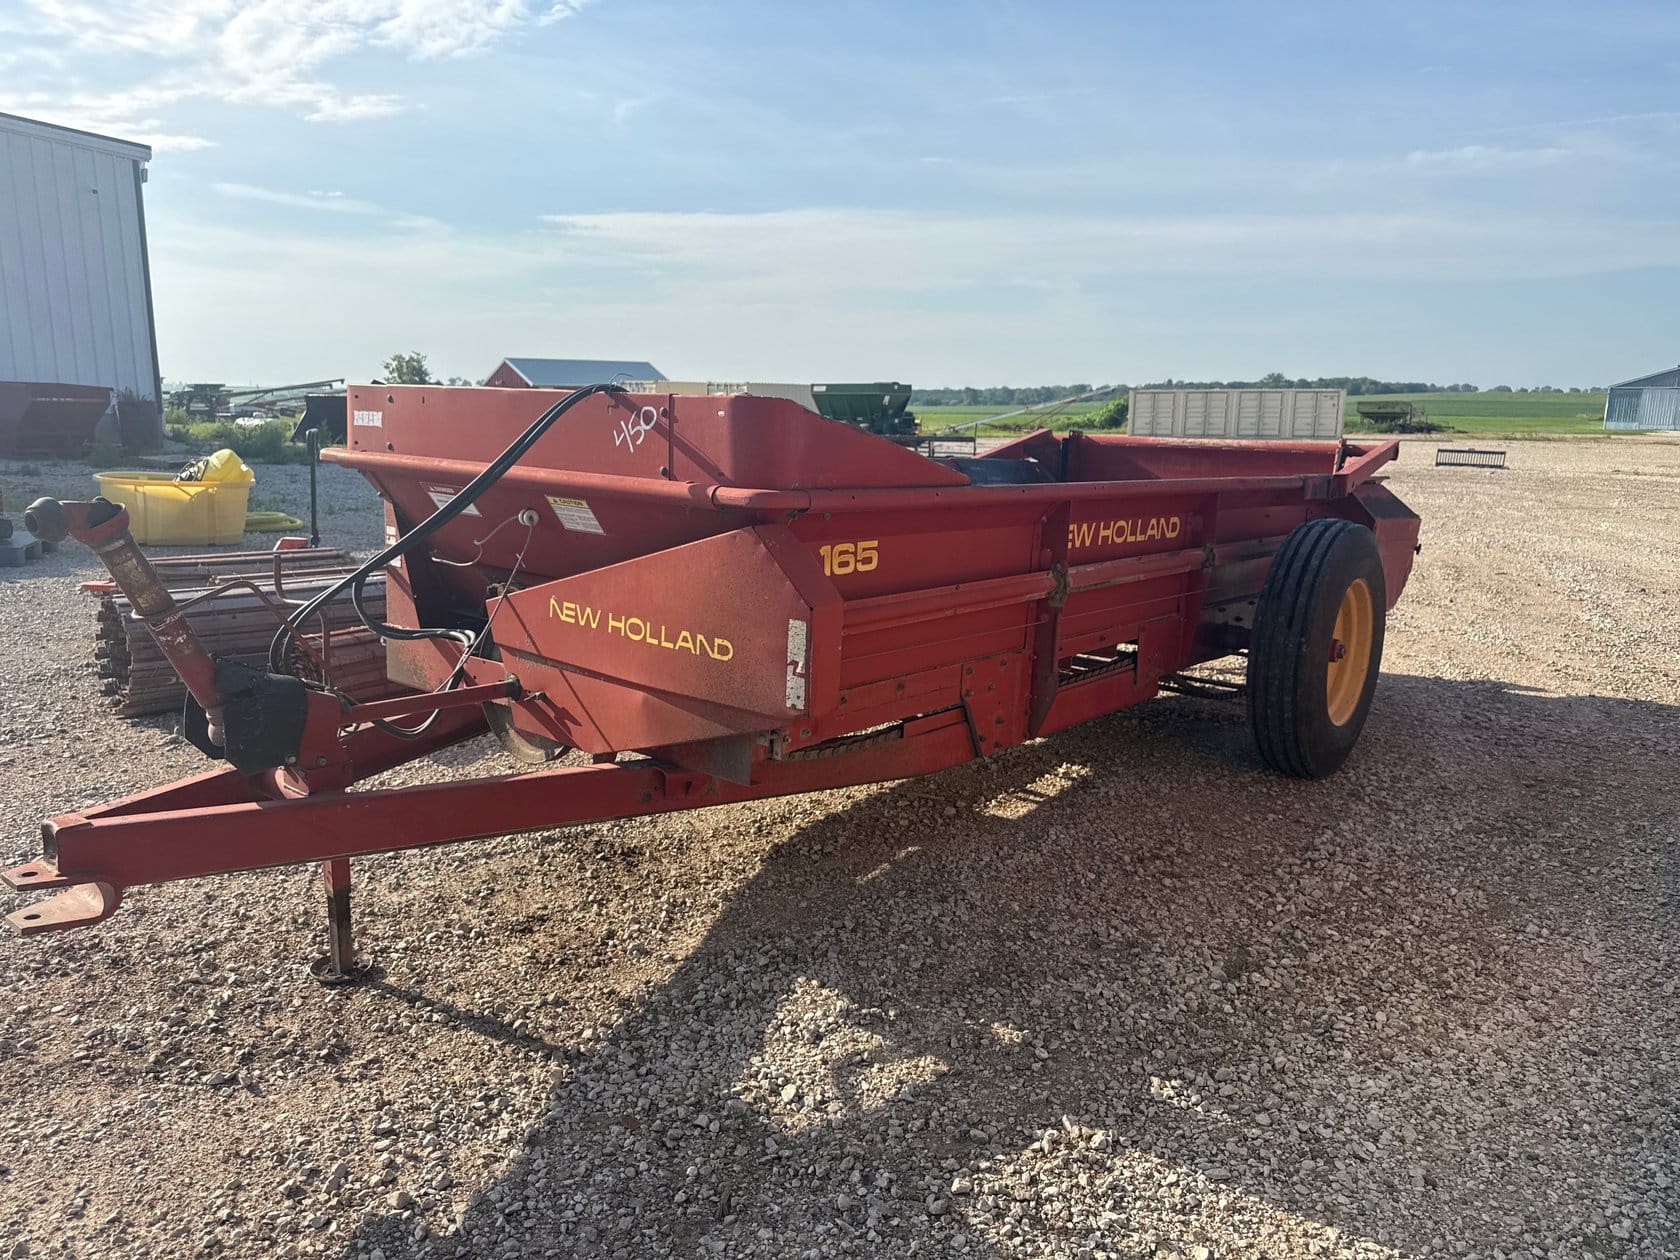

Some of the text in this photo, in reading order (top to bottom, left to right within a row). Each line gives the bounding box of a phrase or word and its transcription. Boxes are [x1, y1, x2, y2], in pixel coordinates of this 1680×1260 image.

[613, 406, 657, 453] 450
[1067, 516, 1180, 549] EW HOLLAND
[819, 540, 879, 577] 165
[550, 597, 734, 661] NEW HOLLAND
